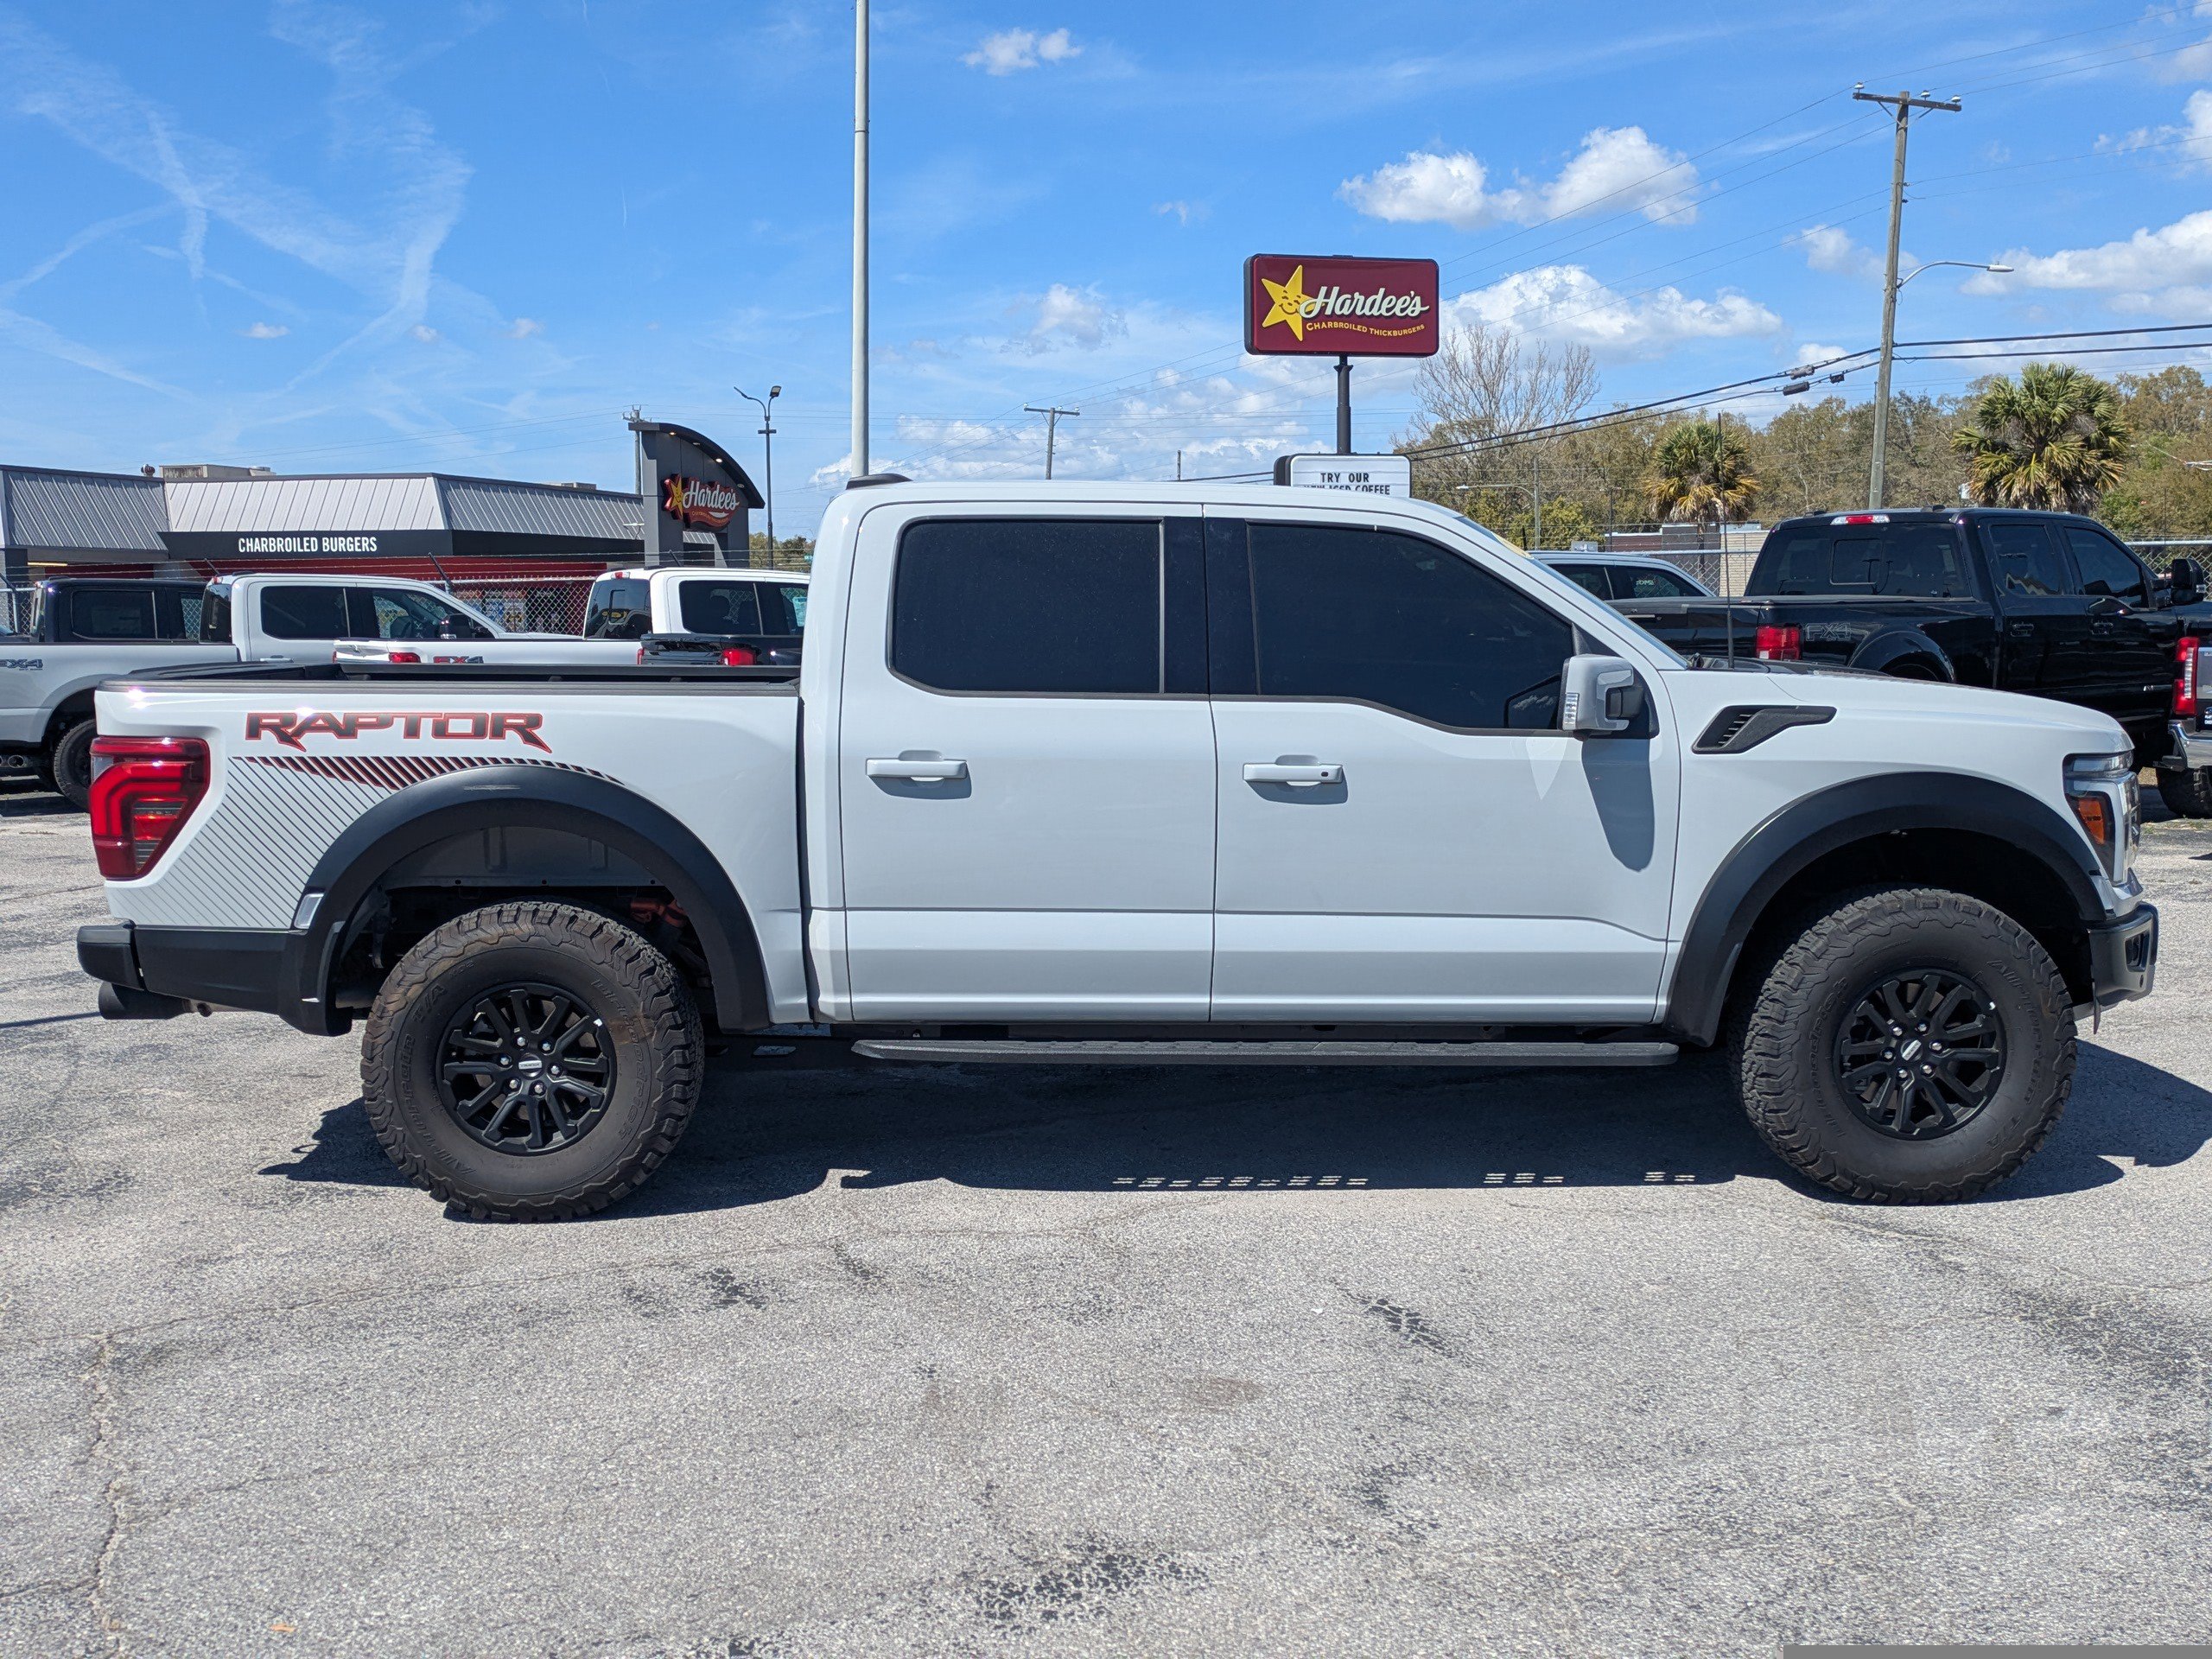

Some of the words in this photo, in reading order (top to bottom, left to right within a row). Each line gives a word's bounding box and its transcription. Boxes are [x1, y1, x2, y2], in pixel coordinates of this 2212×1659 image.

[1299, 286, 1430, 318] Hardee's
[1306, 321, 1368, 333] CHARBROILED
[1369, 324, 1425, 336] THICKBURGERS
[1320, 473, 1341, 483] TRY
[1348, 473, 1370, 483] OUR
[683, 480, 740, 511] Hardee's
[1355, 485, 1390, 495] COFFEE
[238, 537, 318, 552] CHARBROILED
[321, 537, 378, 552] BURGERS
[245, 712, 552, 753] RAPTOR
